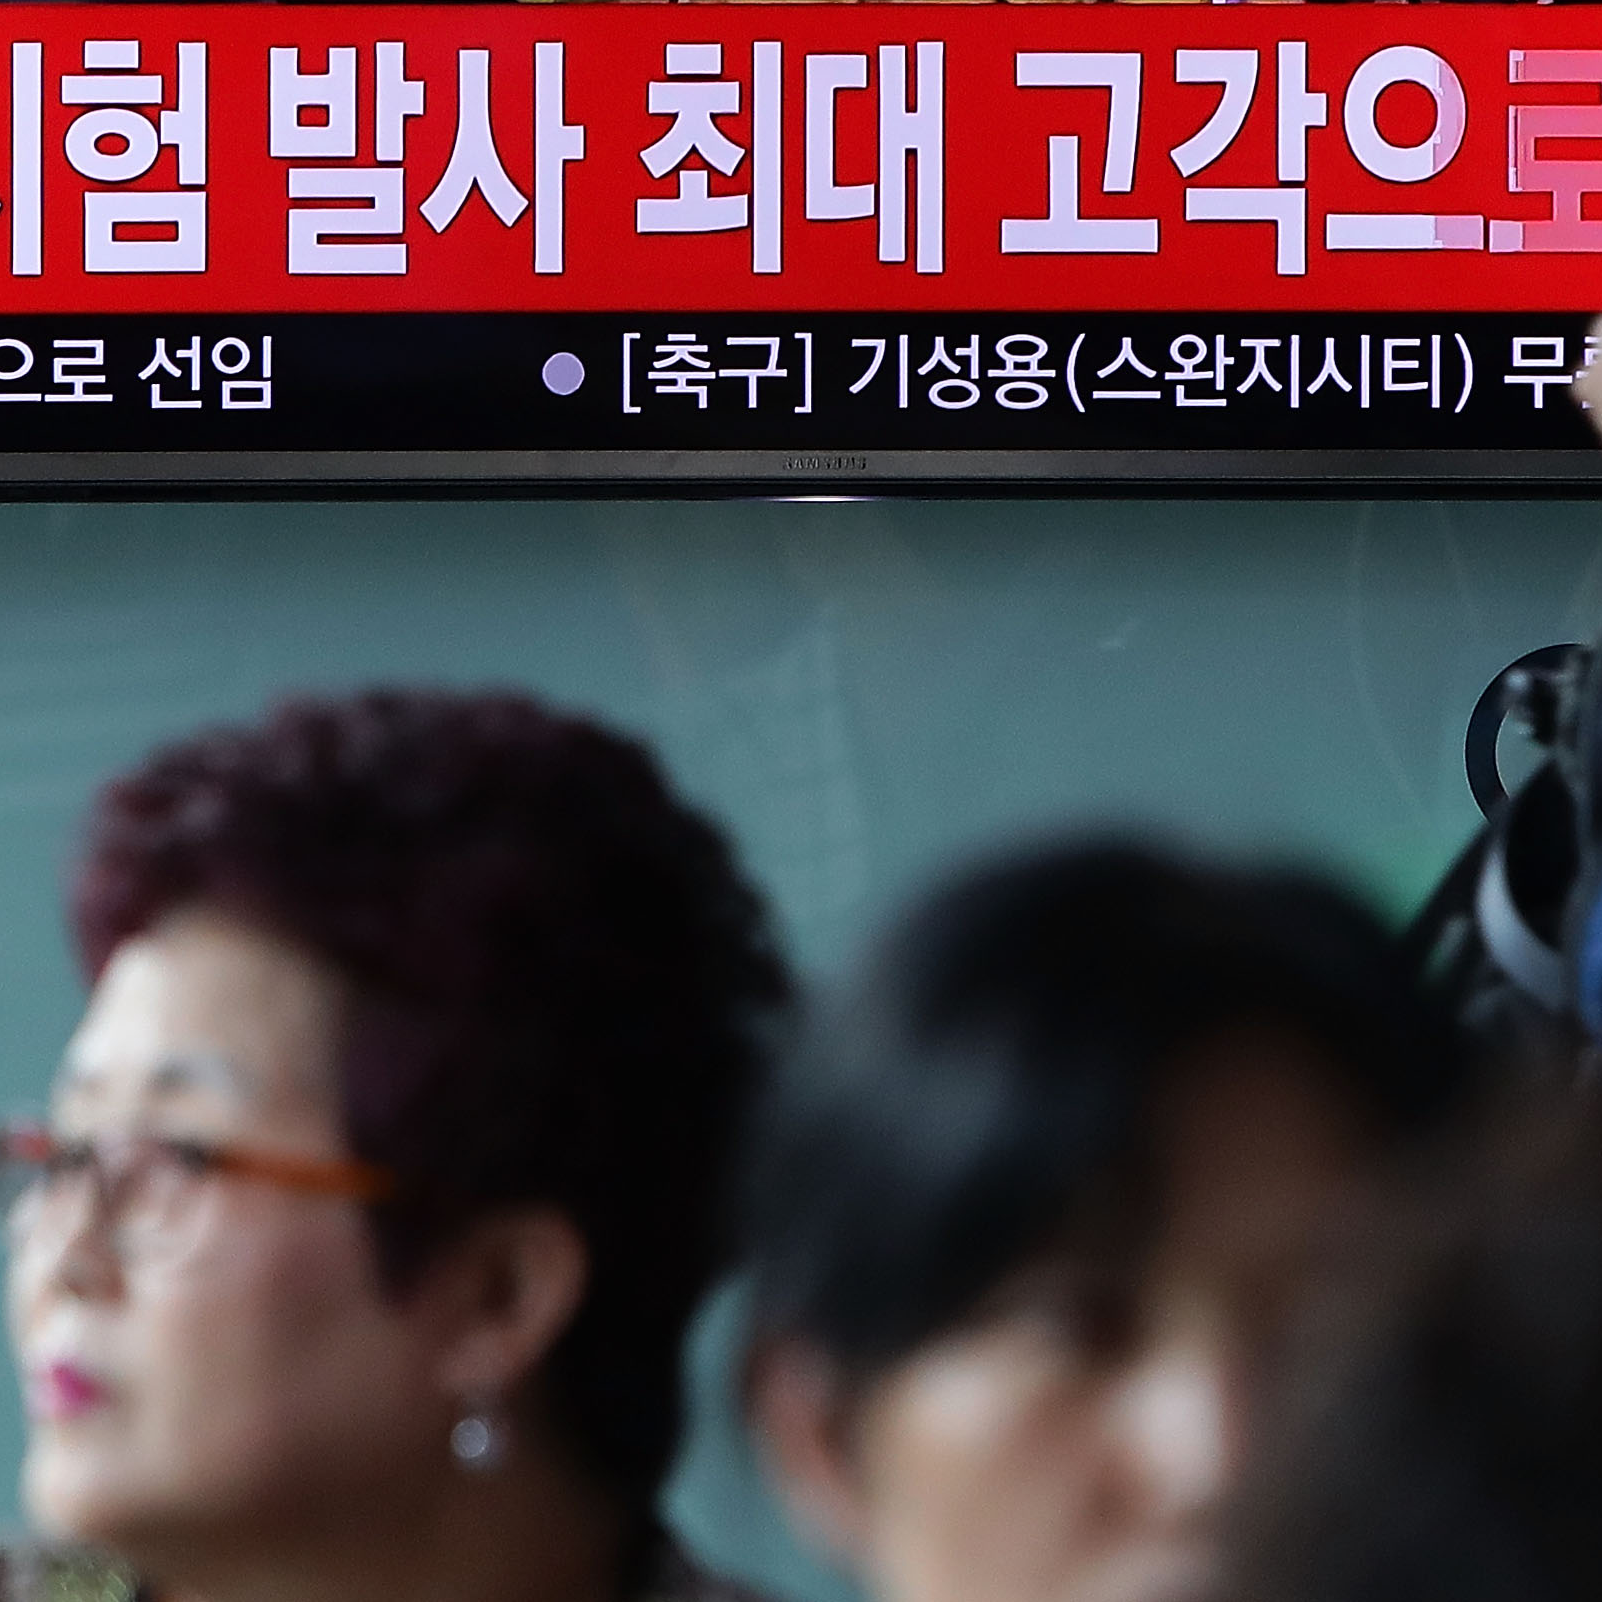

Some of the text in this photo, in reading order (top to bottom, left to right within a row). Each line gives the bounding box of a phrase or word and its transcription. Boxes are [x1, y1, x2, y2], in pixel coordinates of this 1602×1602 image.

[269, 40, 585, 275] 발사
[636, 40, 945, 275] 최대
[138, 334, 274, 410] 선임
[622, 332, 812, 414] [축구]
[848, 332, 1474, 414] 기성용(스완지시티)
